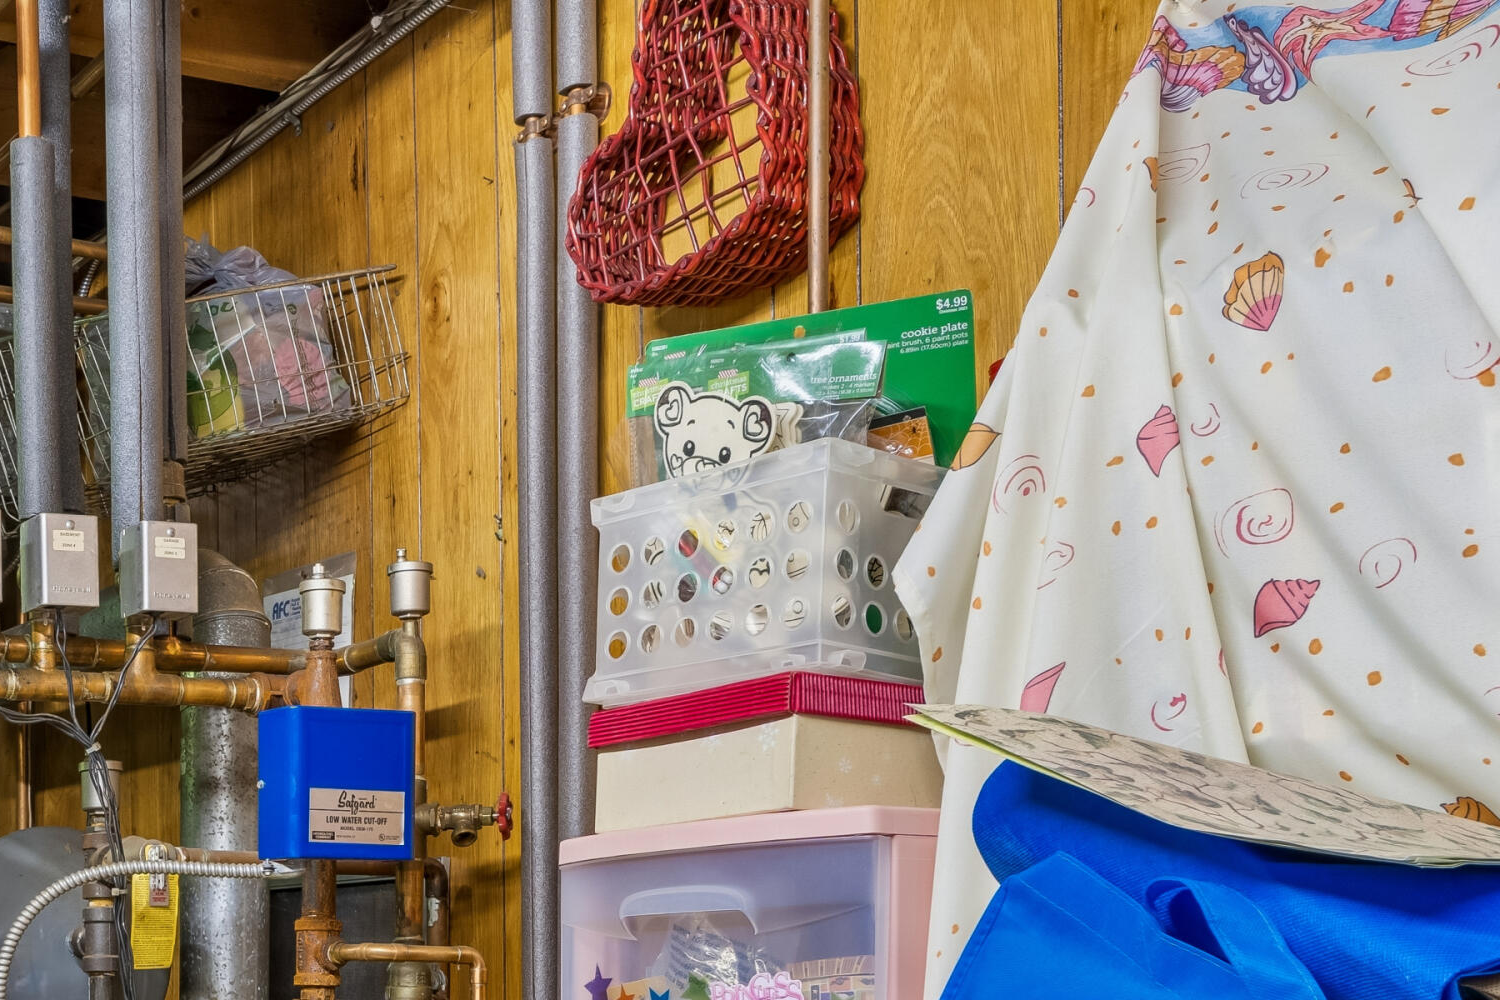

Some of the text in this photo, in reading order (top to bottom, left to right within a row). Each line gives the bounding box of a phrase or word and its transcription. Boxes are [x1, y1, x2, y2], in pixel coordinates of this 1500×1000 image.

[935, 295, 968, 310] $4.99
[901, 322, 968, 339] cookie plate
[932, 335, 950, 343] paint
[952, 332, 968, 340] pots
[828, 373, 877, 384] ornaments
[272, 600, 291, 620] AFC
[338, 790, 376, 815] Safgard
[326, 815, 388, 826] LOW WATER CUT-OFF
